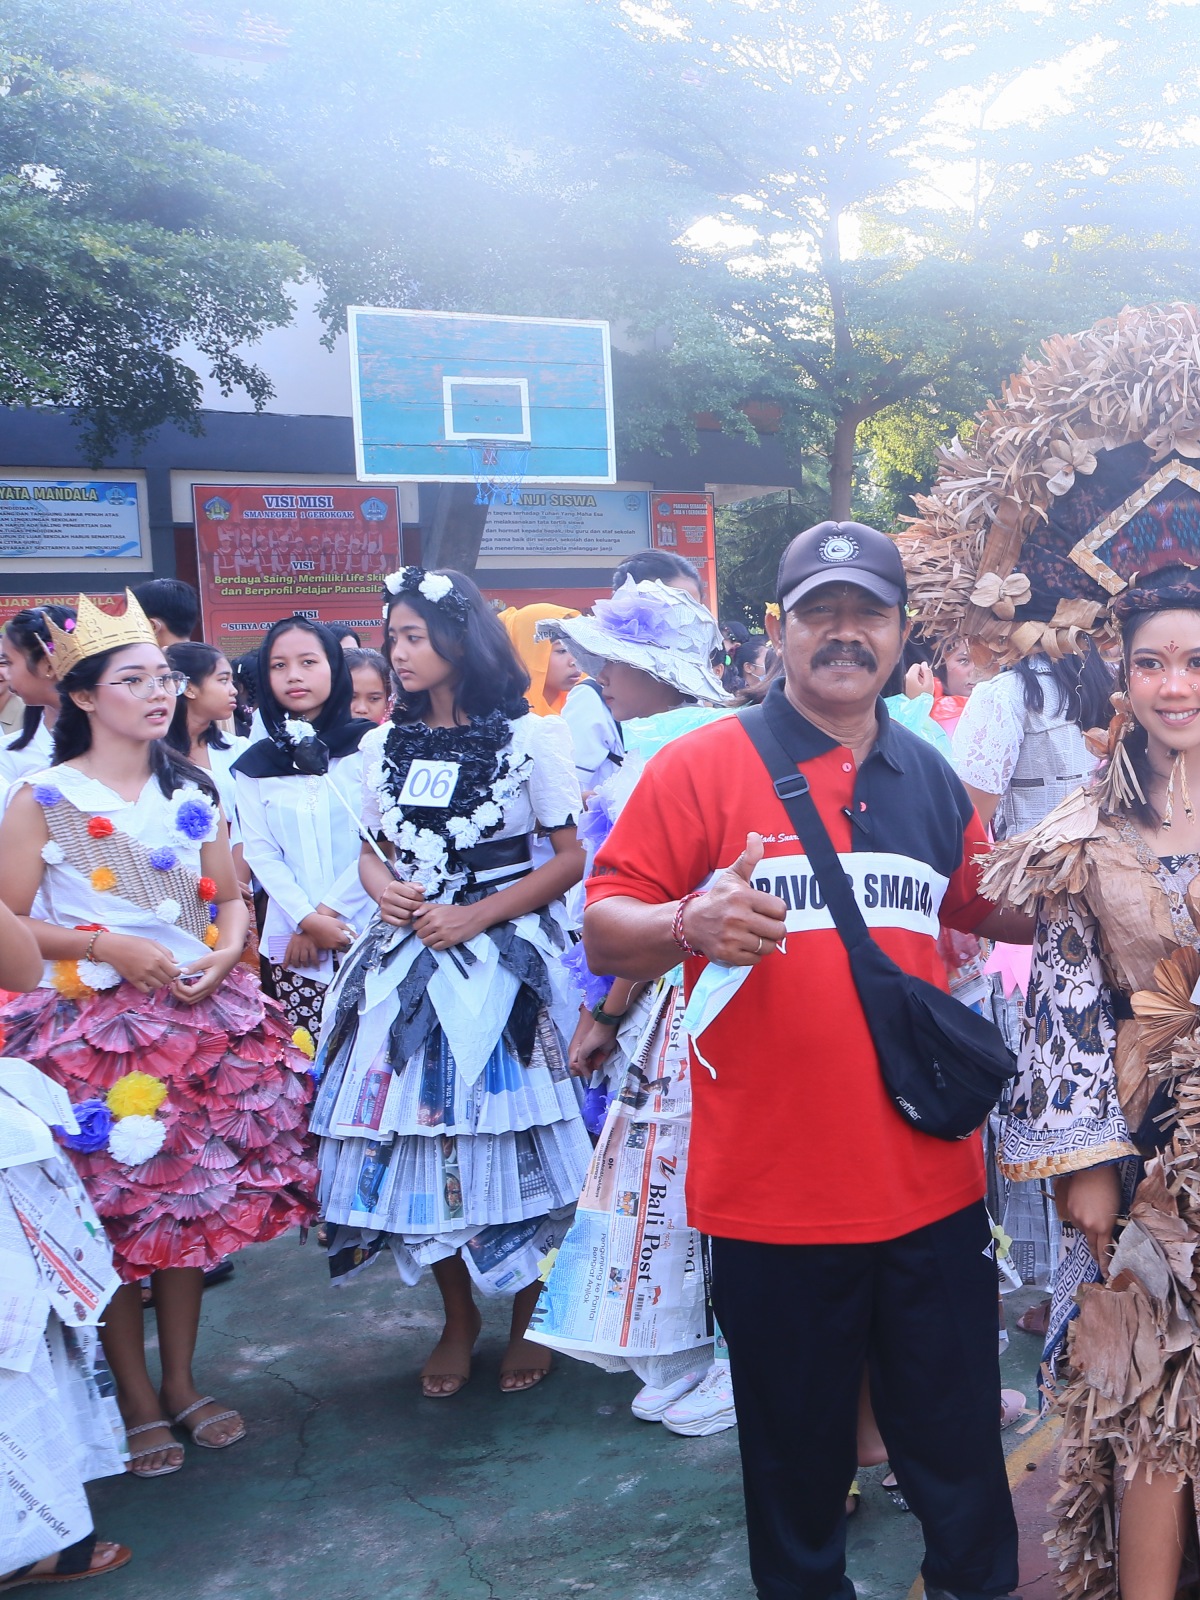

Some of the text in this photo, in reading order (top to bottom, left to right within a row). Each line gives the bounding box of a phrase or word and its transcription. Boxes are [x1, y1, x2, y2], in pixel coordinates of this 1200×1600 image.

[33, 486, 99, 501] MANDALA
[263, 495, 333, 509] VISI MISI
[550, 494, 597, 507] SISWA
[243, 510, 266, 519] SMA
[266, 510, 297, 519] NEGERI
[307, 510, 354, 519] GEROKGAK
[291, 561, 314, 570] VISI
[214, 575, 261, 585] Berdaya
[263, 575, 296, 585] Saing,
[298, 574, 344, 583] Memiliki
[346, 573, 365, 582] Life
[221, 585, 383, 597] dan Berprofil Pelajar Pancasila
[35, 597, 115, 607] PANCILA
[293, 610, 319, 619] MISI
[228, 623, 257, 631] SURYA
[409, 768, 453, 798] 06
[750, 873, 828, 911] RAVO
[668, 1006, 686, 1051] Post
[896, 1096, 922, 1121] rattler
[646, 1184, 667, 1225] Bali
[638, 1232, 661, 1283] Post
[589, 1233, 607, 1321] Pengunjung ke Pantai
[582, 1279, 593, 1304] Anjlok
[0, 1431, 28, 1460] HEALTH
[36, 1503, 71, 1539] Korslet
